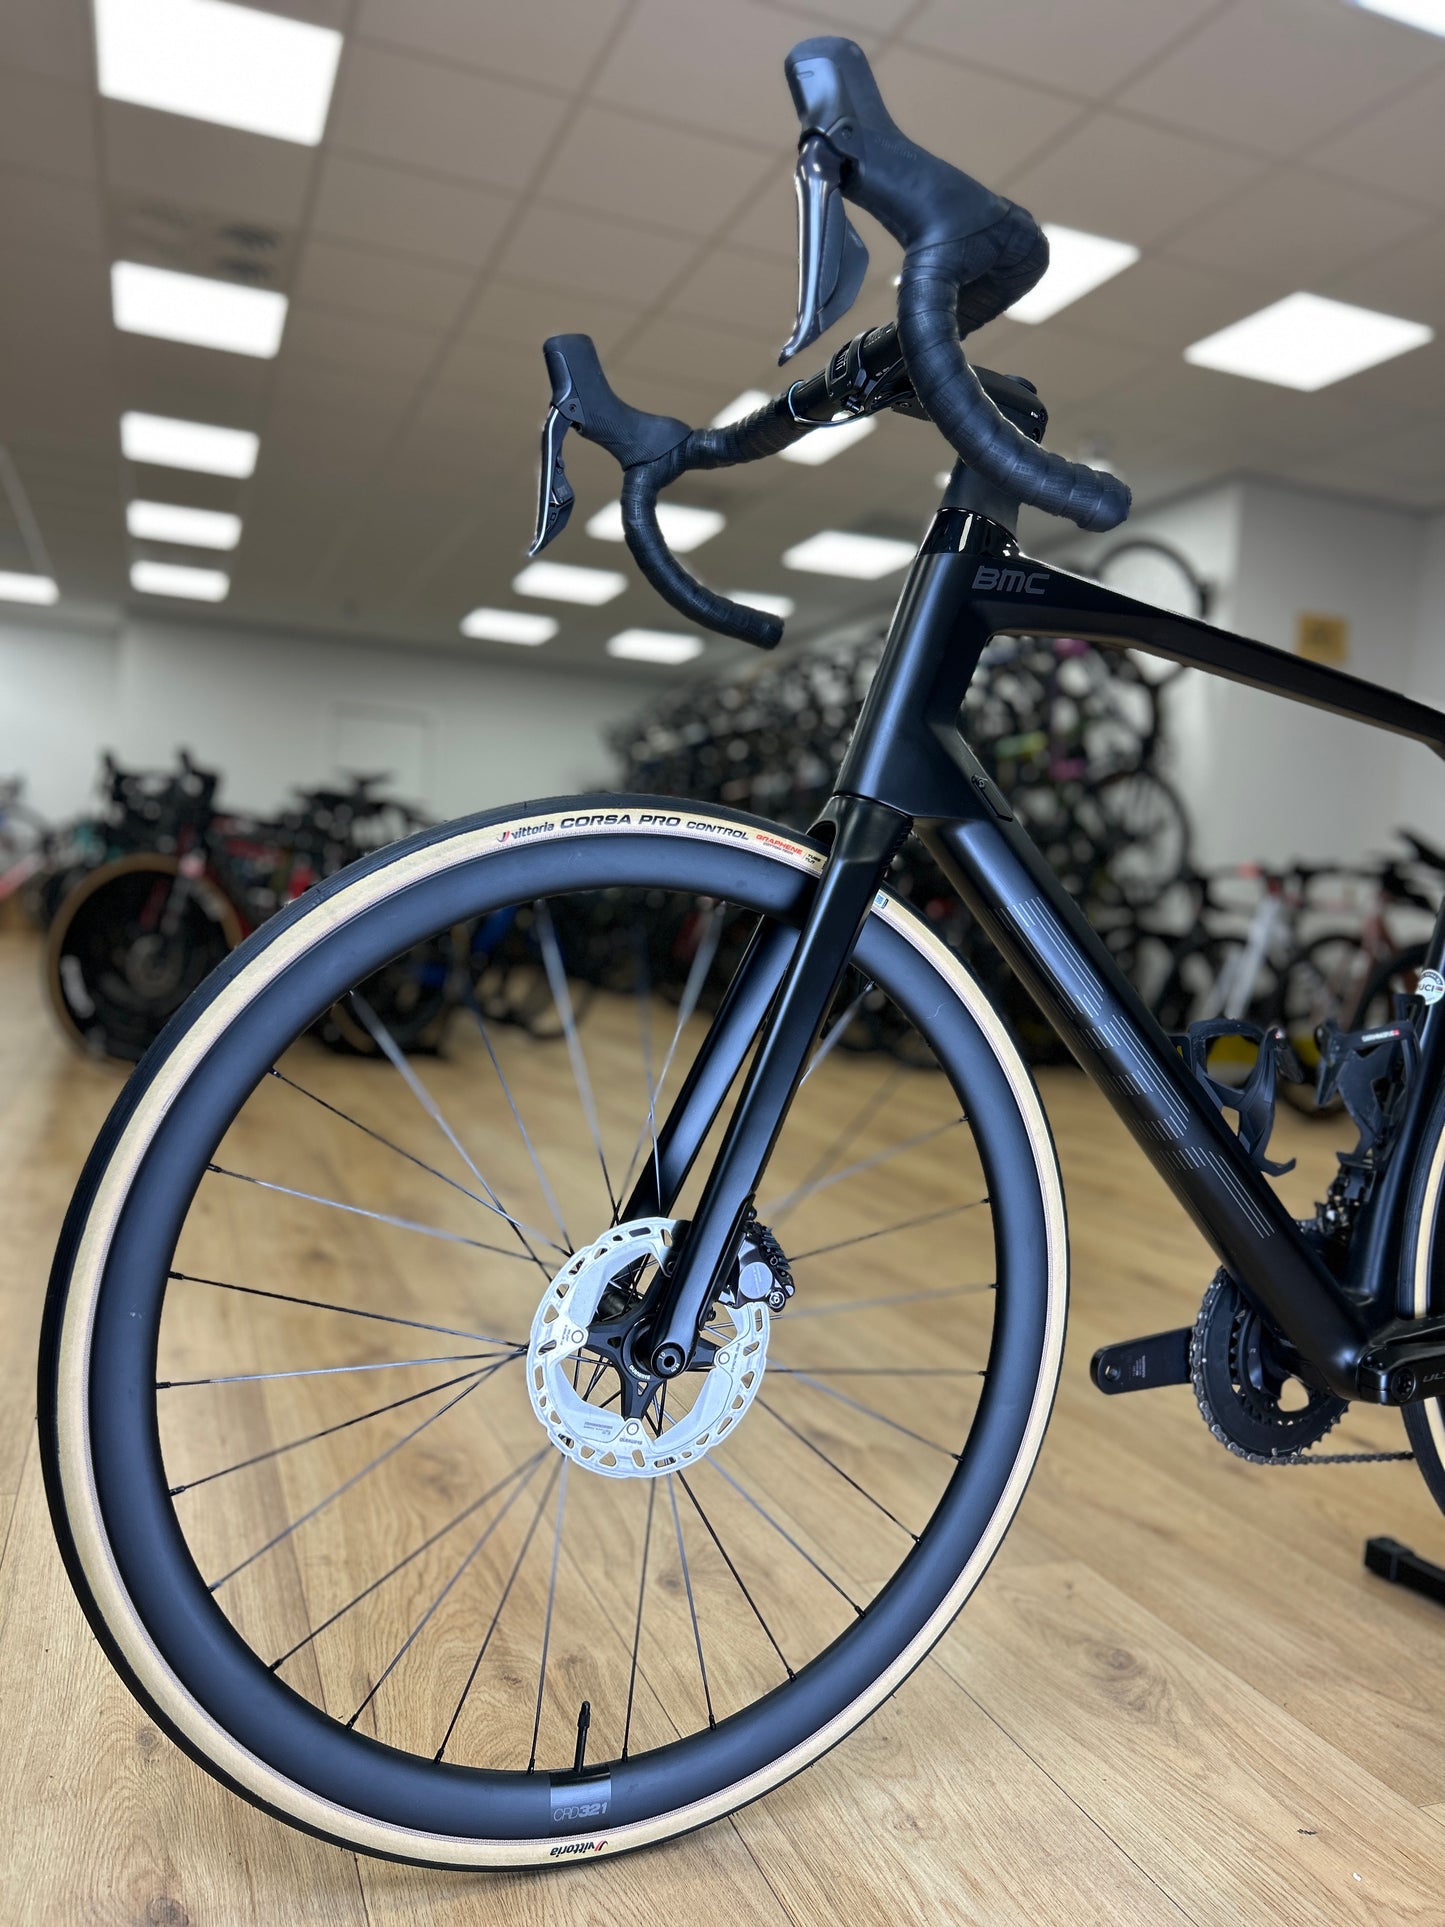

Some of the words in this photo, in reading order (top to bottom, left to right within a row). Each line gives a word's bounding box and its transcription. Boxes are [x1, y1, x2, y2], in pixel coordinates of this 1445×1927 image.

[972, 565, 1050, 595] BMC
[511, 821, 554, 839] vittoria
[560, 814, 632, 829] CORSA
[638, 815, 682, 828] PRO
[686, 821, 749, 841] CONTROL
[756, 834, 803, 854] GRAPHENE
[550, 1841, 595, 1858] vittoria
